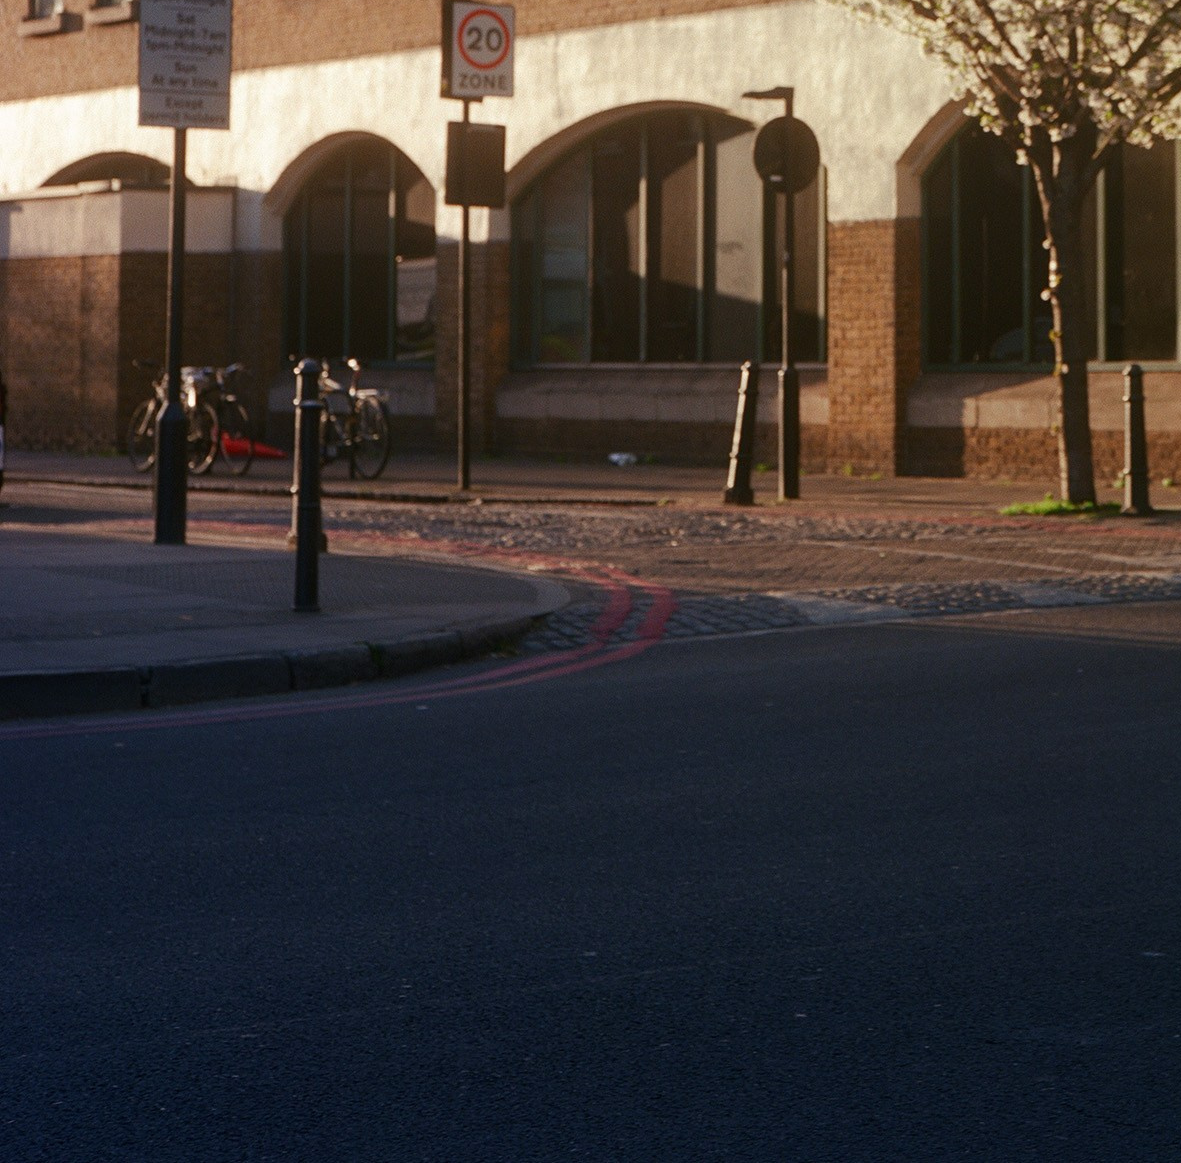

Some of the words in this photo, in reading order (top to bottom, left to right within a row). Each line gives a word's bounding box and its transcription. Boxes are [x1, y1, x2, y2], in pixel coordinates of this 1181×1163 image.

[177, 12, 196, 24] Sat
[467, 27, 502, 52] 20
[175, 61, 197, 73] Sun
[459, 73, 508, 91] ZONE
